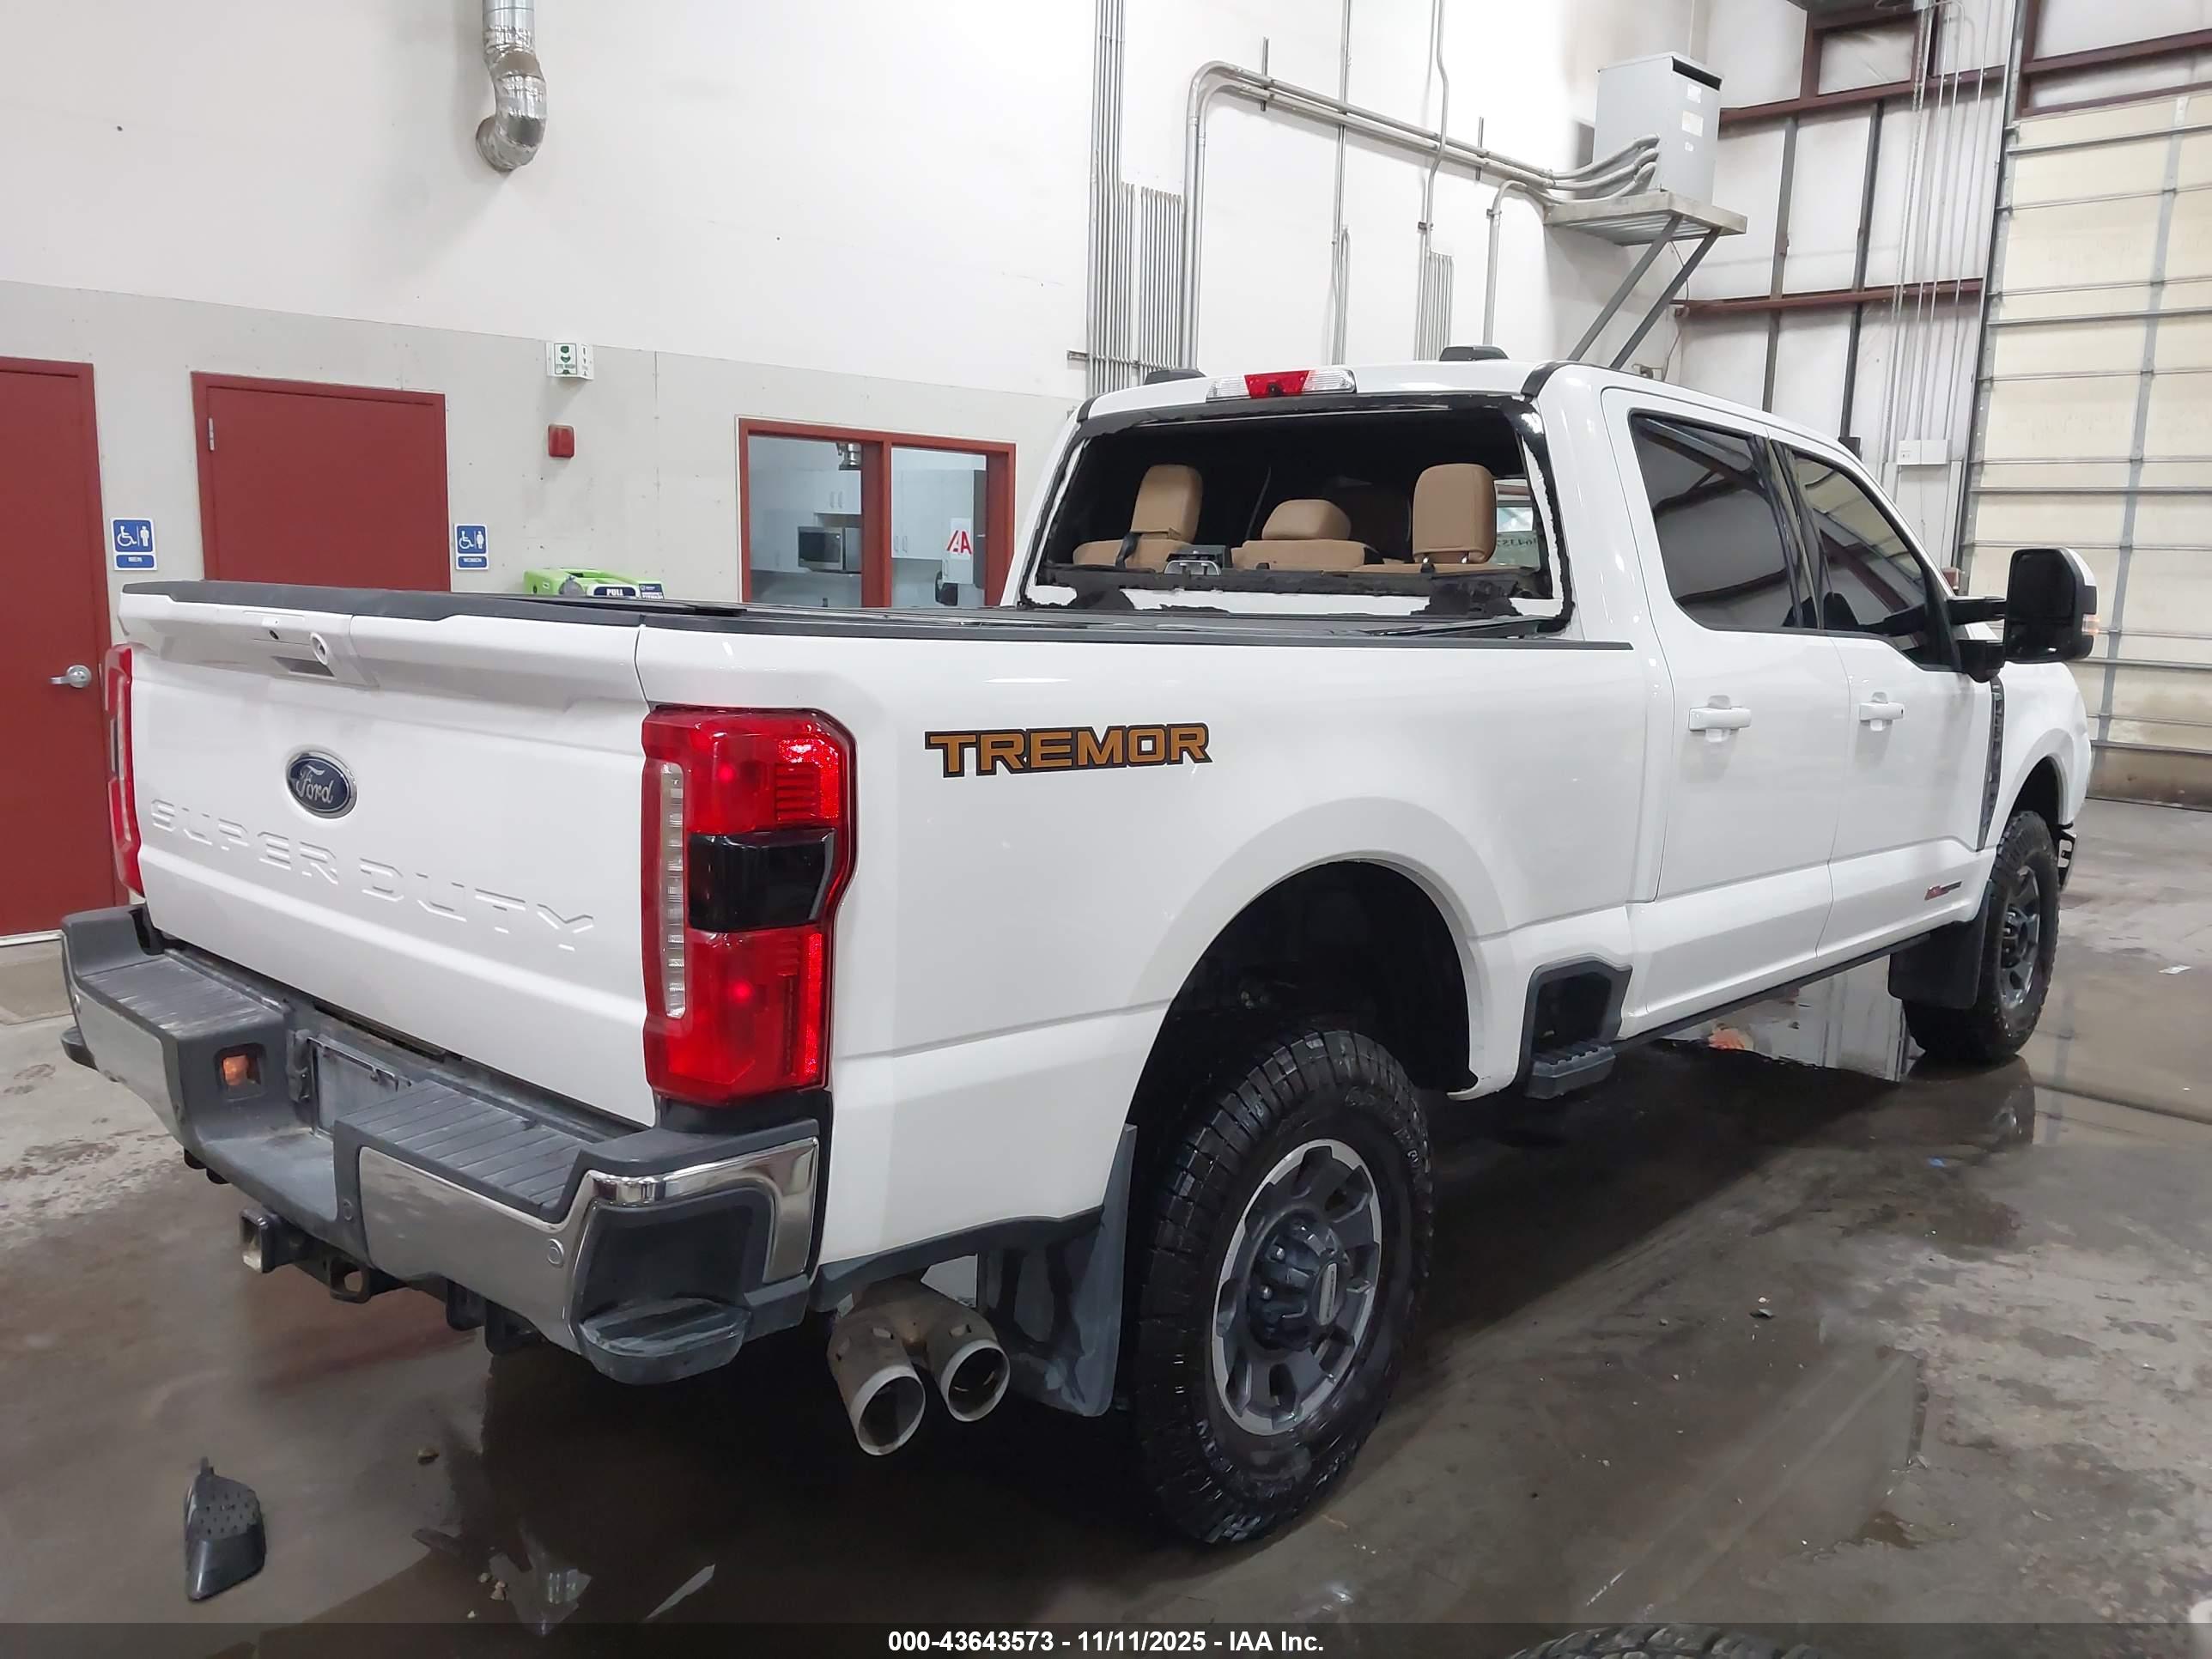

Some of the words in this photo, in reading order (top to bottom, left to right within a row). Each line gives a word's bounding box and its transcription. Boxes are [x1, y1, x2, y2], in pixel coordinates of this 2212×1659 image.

[606, 588, 624, 597] PULL
[925, 723, 1212, 778] TREMOR
[295, 764, 335, 804] Ford
[151, 799, 338, 884] SUPER
[359, 858, 594, 951] DUTY
